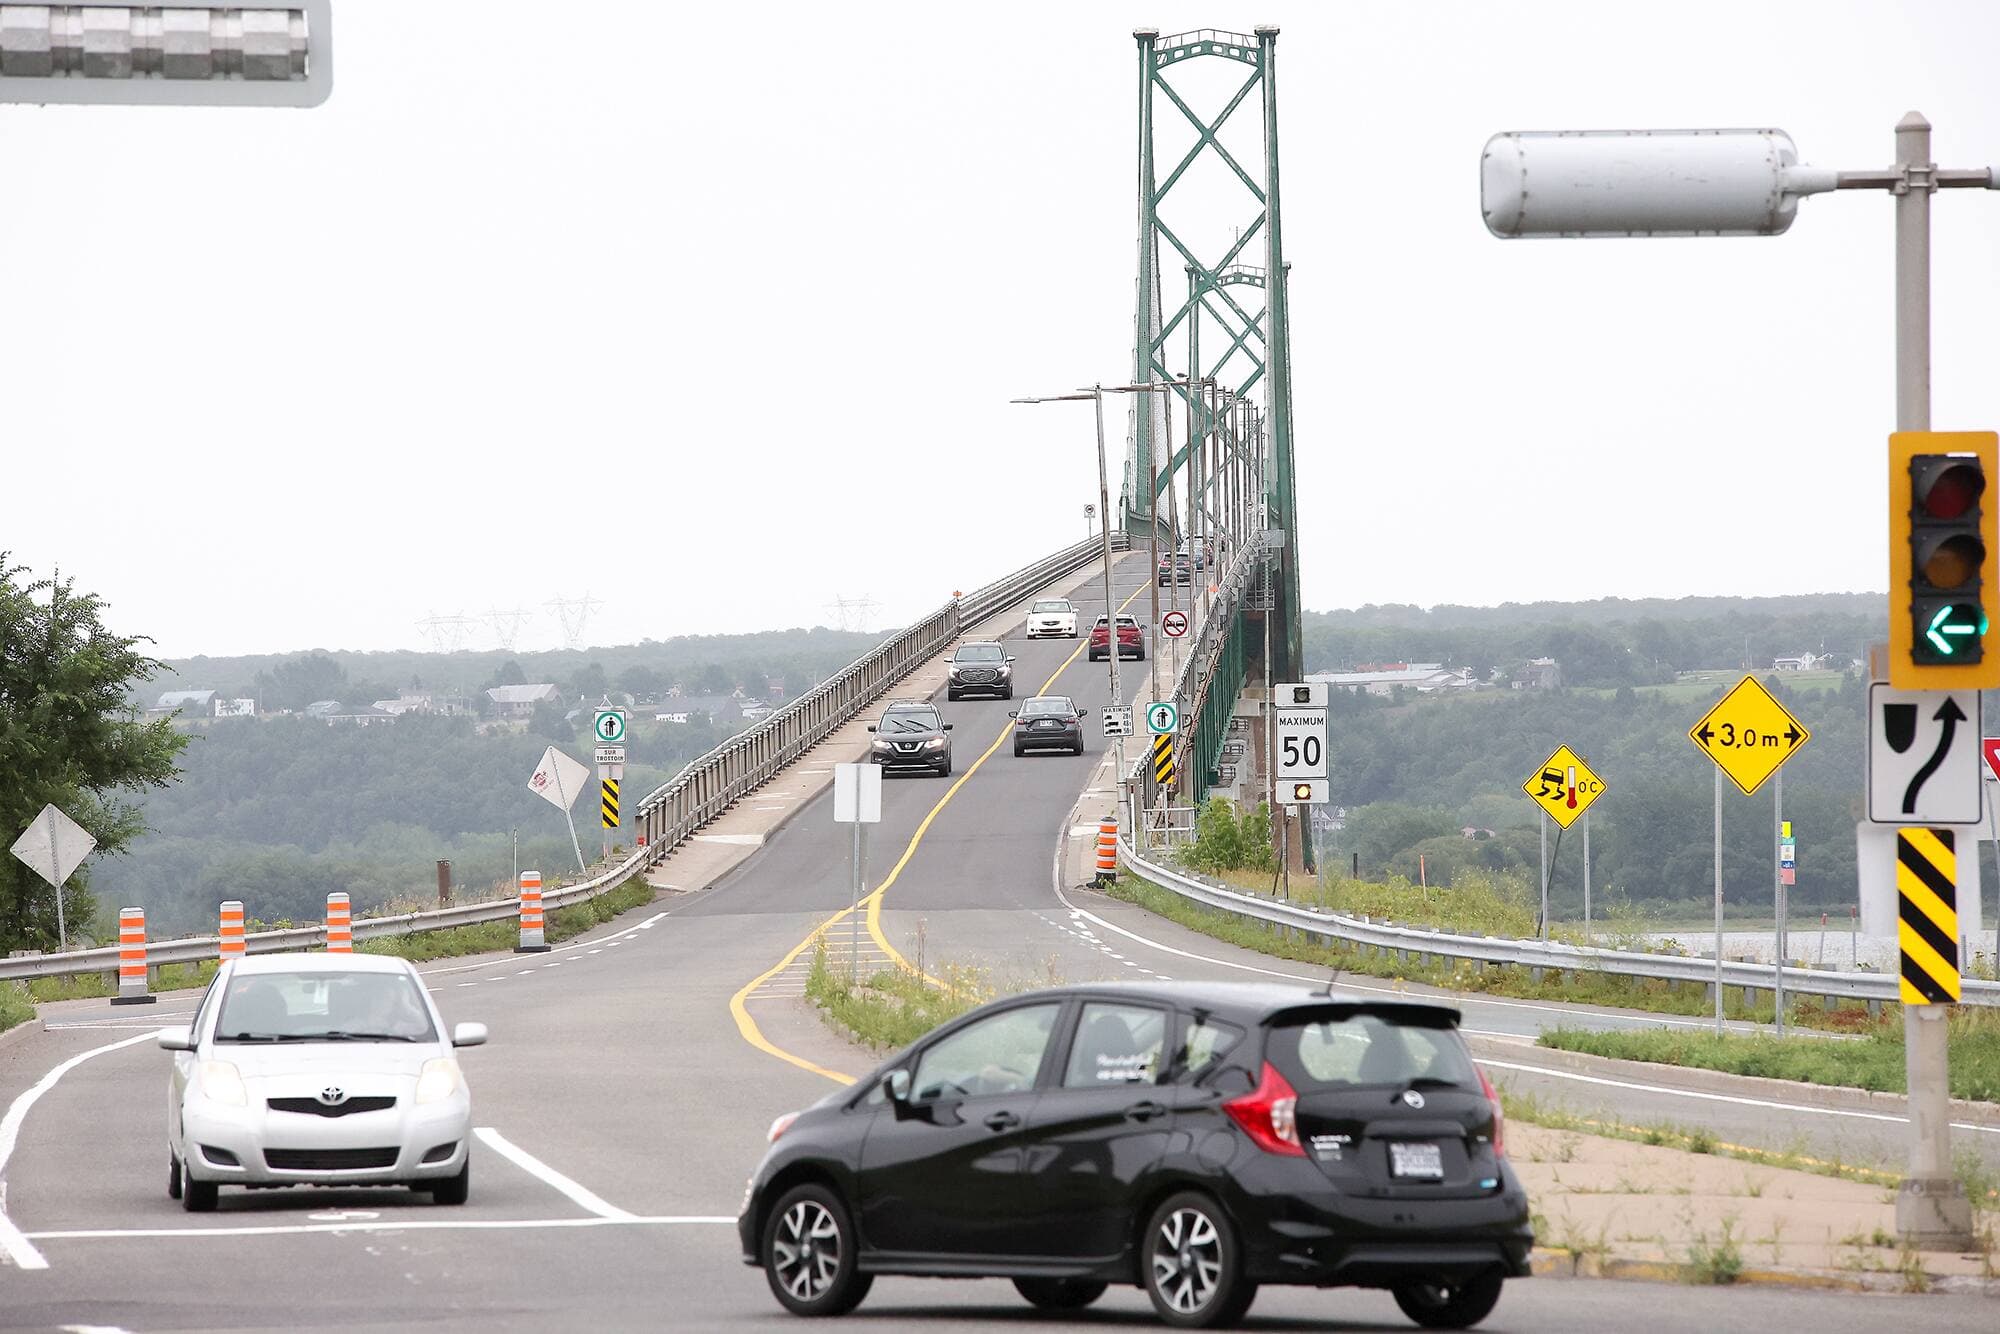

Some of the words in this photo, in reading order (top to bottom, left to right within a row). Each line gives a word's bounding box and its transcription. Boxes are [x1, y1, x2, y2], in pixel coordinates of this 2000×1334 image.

[1279, 717, 1324, 726] MAXIMUM
[1720, 722, 1756, 749] 3,0
[1762, 734, 1778, 747] m
[1283, 735, 1321, 768] 50
